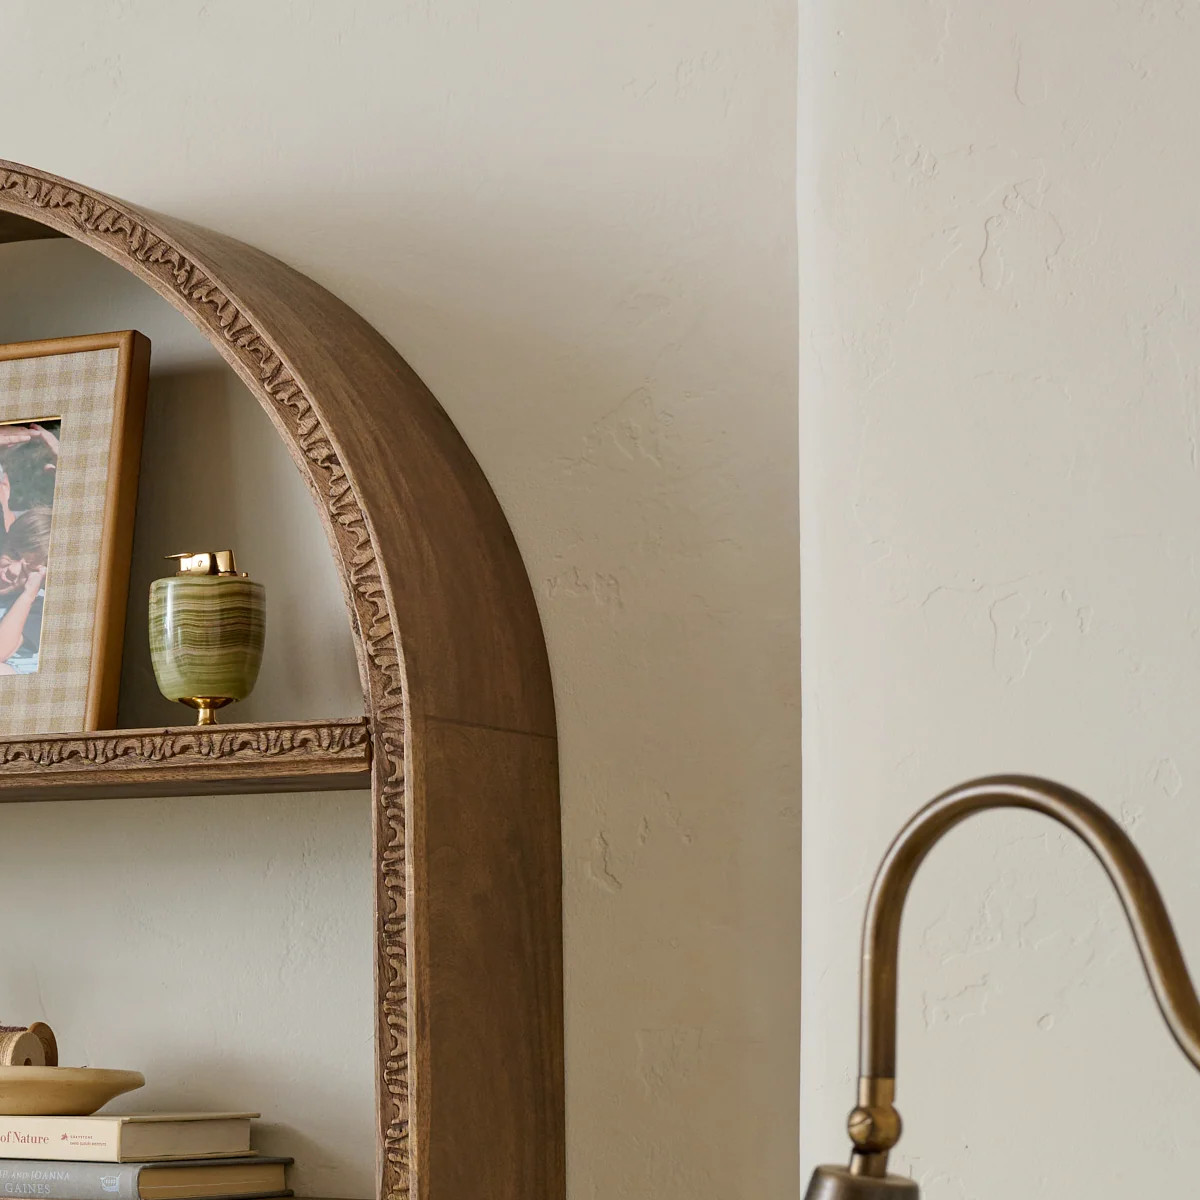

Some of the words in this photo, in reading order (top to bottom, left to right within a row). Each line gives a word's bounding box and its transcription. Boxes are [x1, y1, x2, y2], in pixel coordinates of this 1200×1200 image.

[0, 1131, 12, 1143] of
[12, 1131, 50, 1144] Nature
[4, 1182, 52, 1194] GAINES
